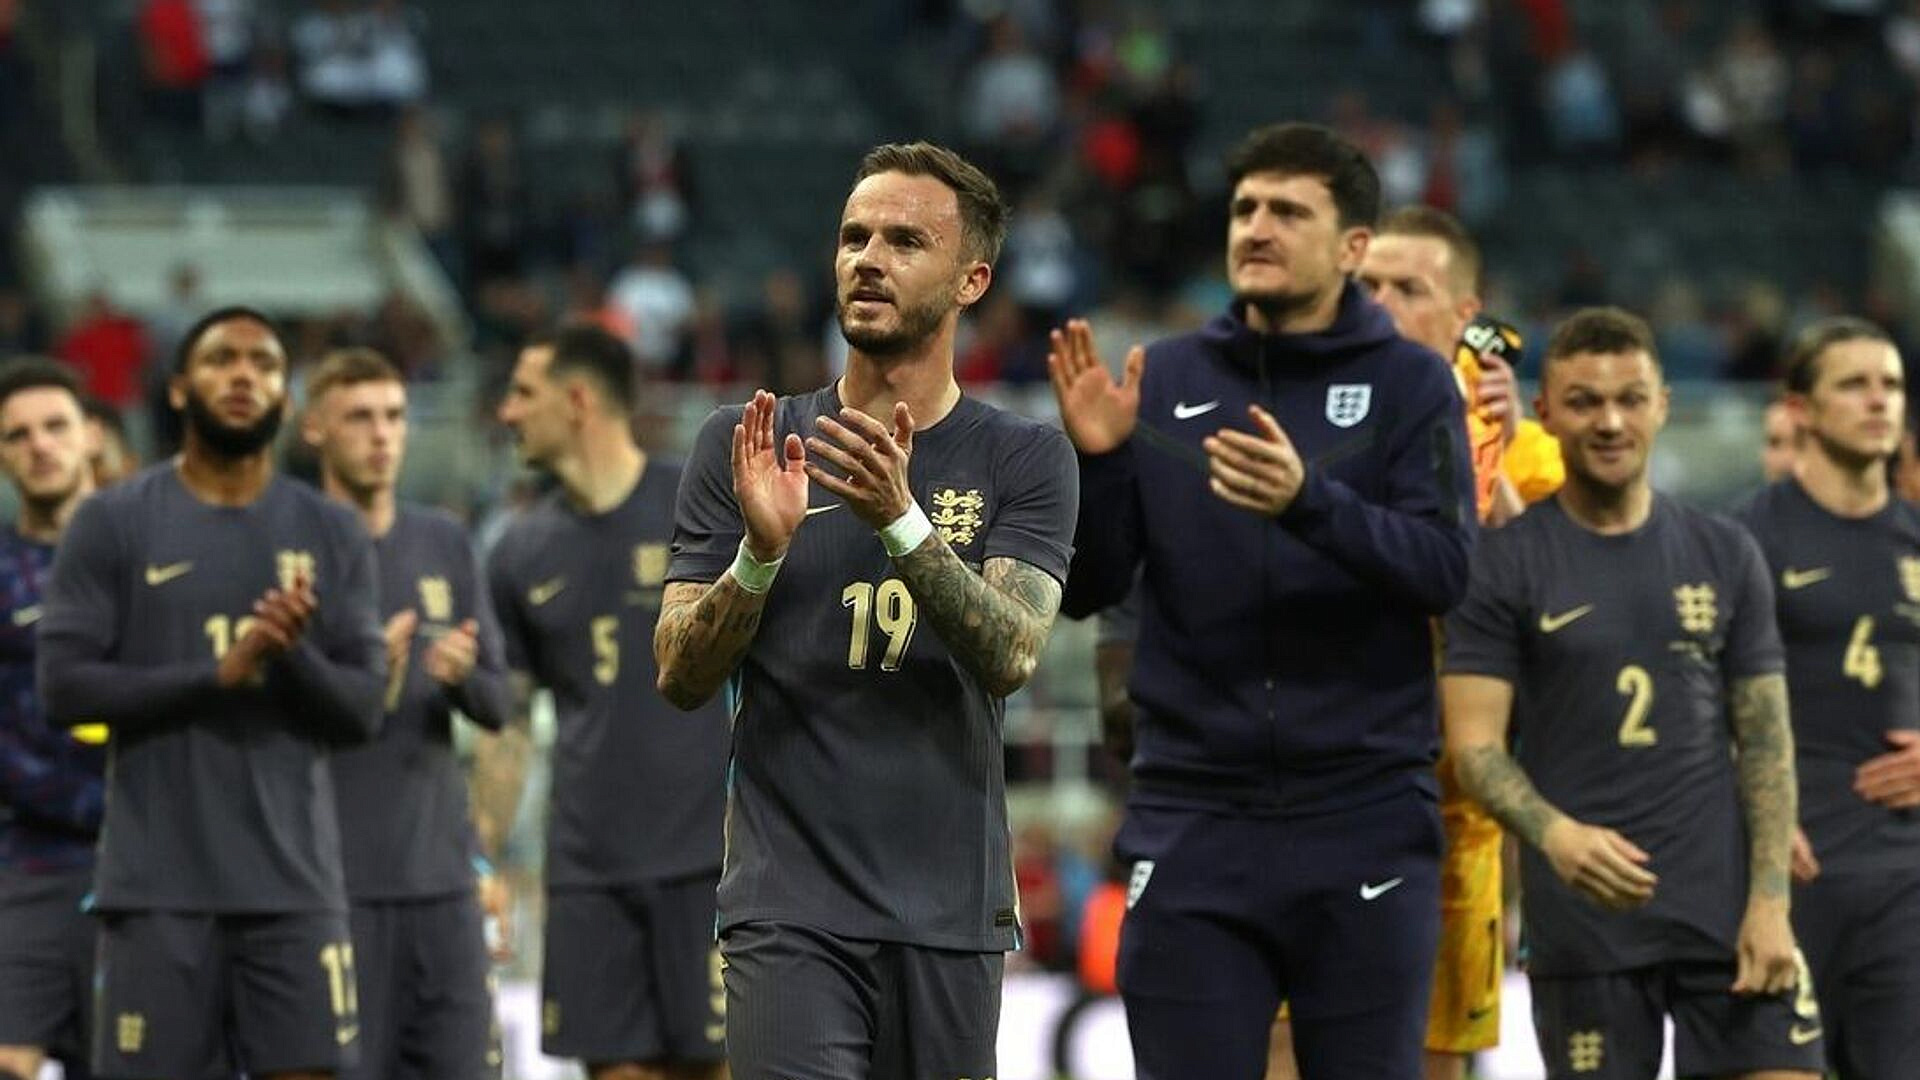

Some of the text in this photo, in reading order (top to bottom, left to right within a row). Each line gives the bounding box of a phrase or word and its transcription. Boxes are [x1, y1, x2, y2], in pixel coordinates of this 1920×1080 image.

[591, 615, 621, 685] 5
[841, 578, 918, 672] 19
[1843, 613, 1883, 688] 4
[1616, 664, 1658, 746] 2
